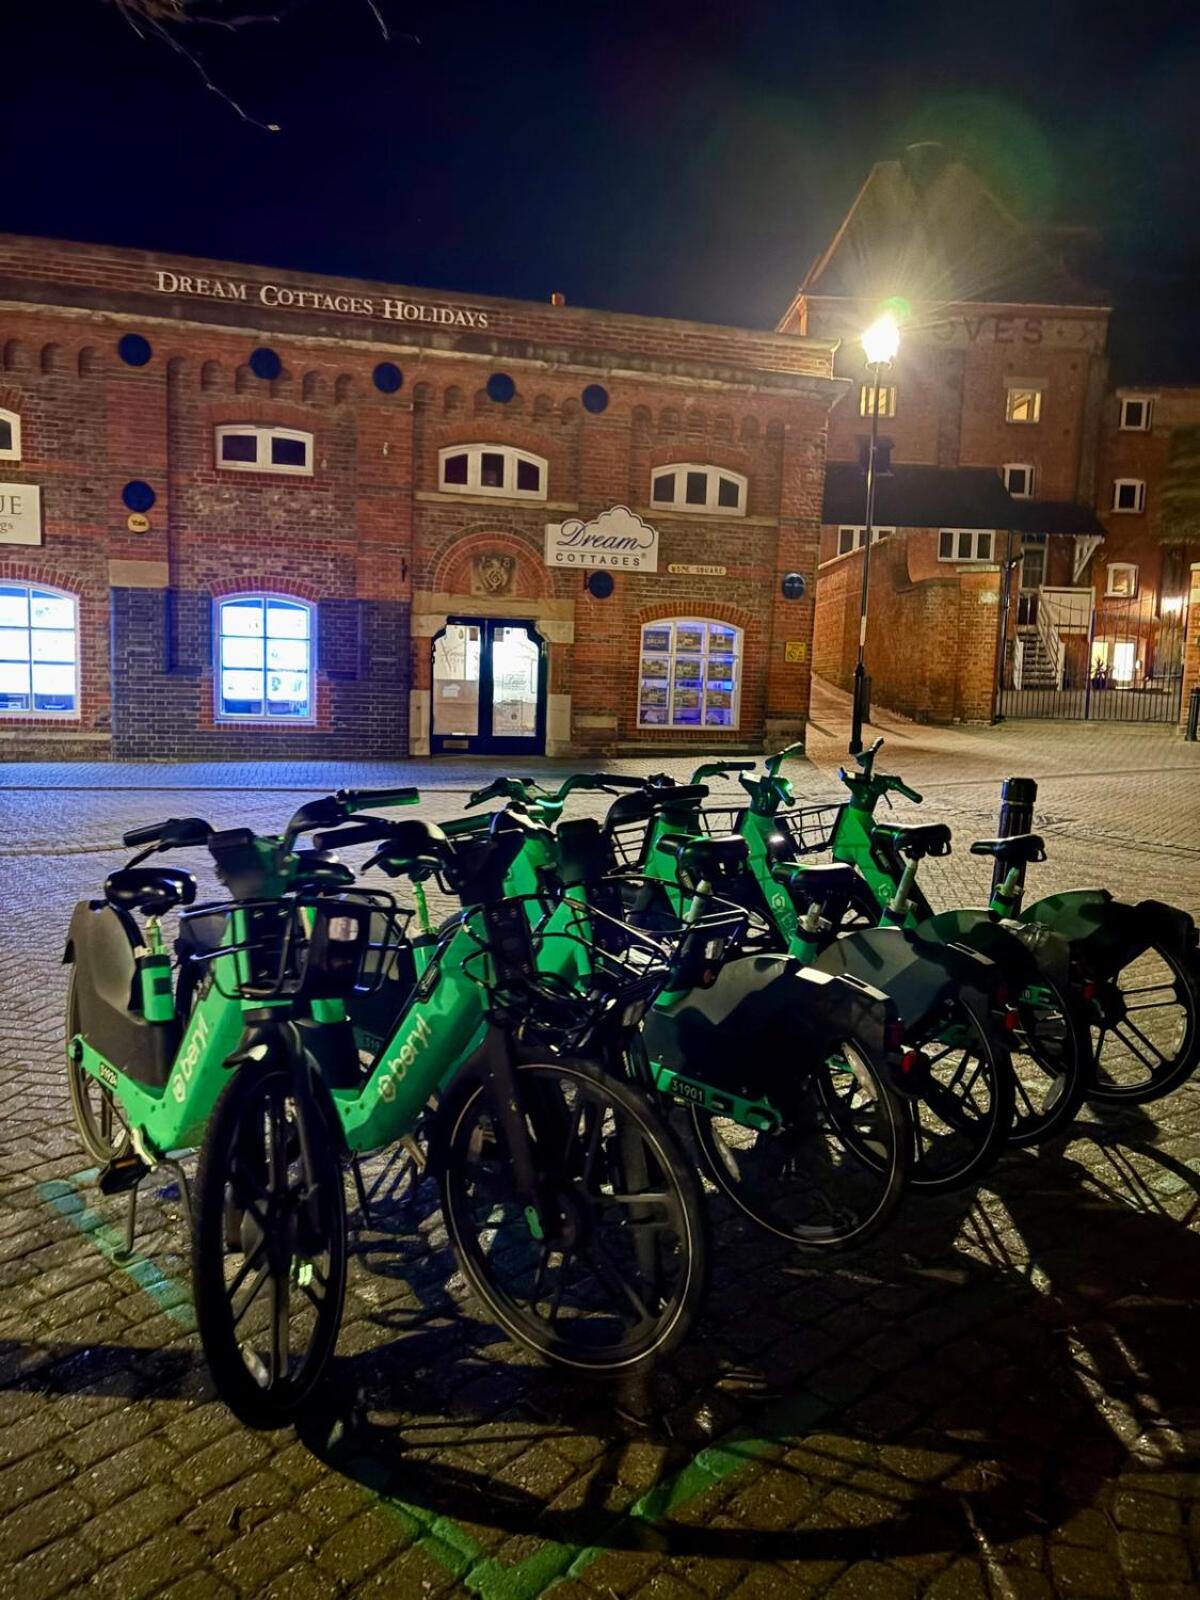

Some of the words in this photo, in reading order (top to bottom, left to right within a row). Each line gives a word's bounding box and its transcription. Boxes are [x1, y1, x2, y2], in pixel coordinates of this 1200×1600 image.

[156, 270, 247, 300] DREAM
[259, 284, 374, 315] COTTAGES
[382, 298, 489, 328] HOLIDAYS
[556, 519, 642, 550] Dream
[556, 553, 640, 567] COTTAGES
[180, 1012, 209, 1078] beryl
[388, 1013, 432, 1081] beryl
